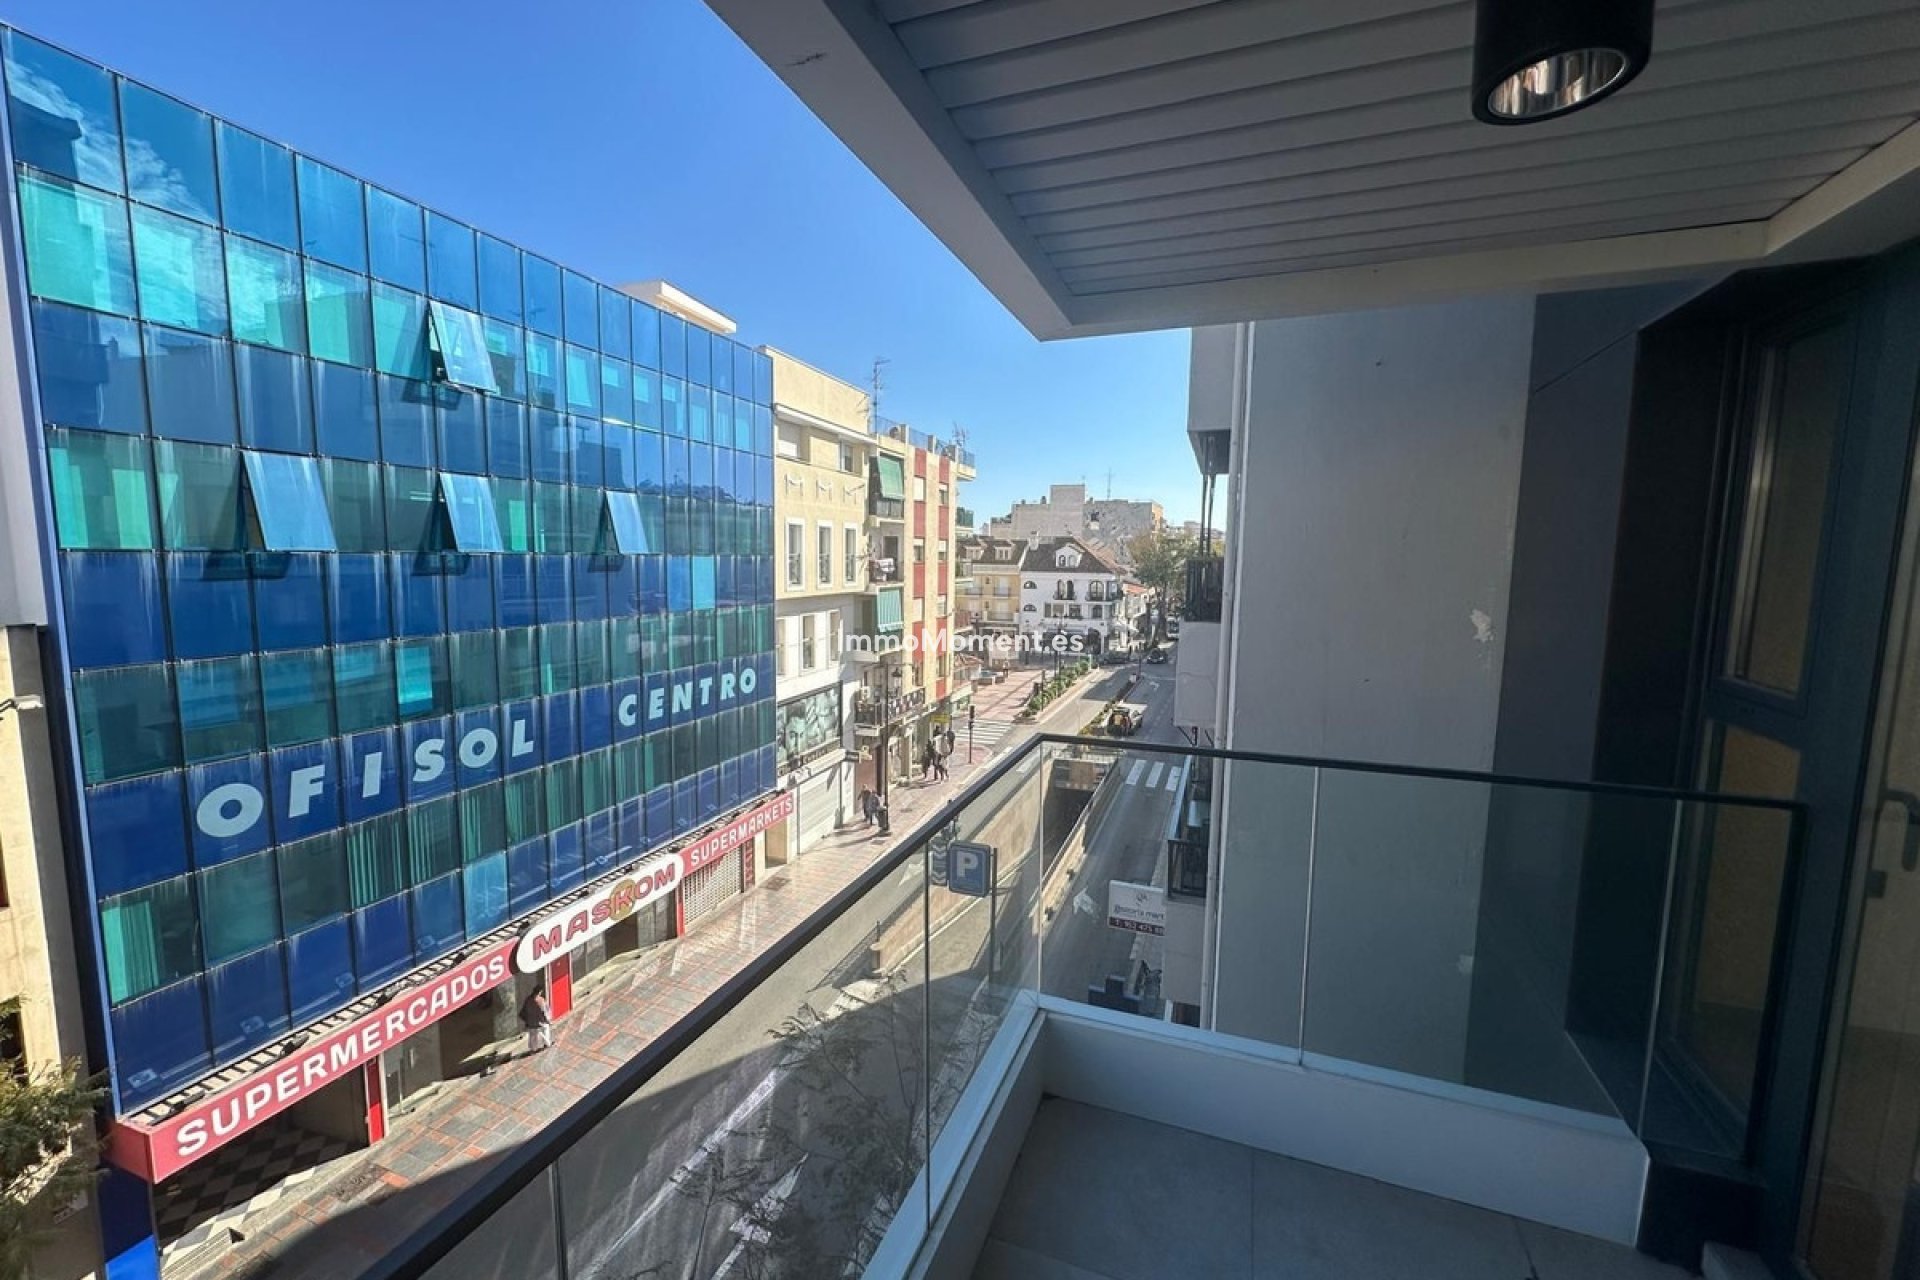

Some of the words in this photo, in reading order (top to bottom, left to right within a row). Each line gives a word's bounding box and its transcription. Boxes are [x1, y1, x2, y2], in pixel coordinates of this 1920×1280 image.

[196, 719, 535, 838] OFISOL
[618, 667, 757, 727] CENTRO
[956, 850, 979, 878] P
[176, 953, 506, 1158] SUPERMERCADOS
[532, 862, 676, 961] MASKOM
[689, 797, 794, 867] SUPERMARKETS
